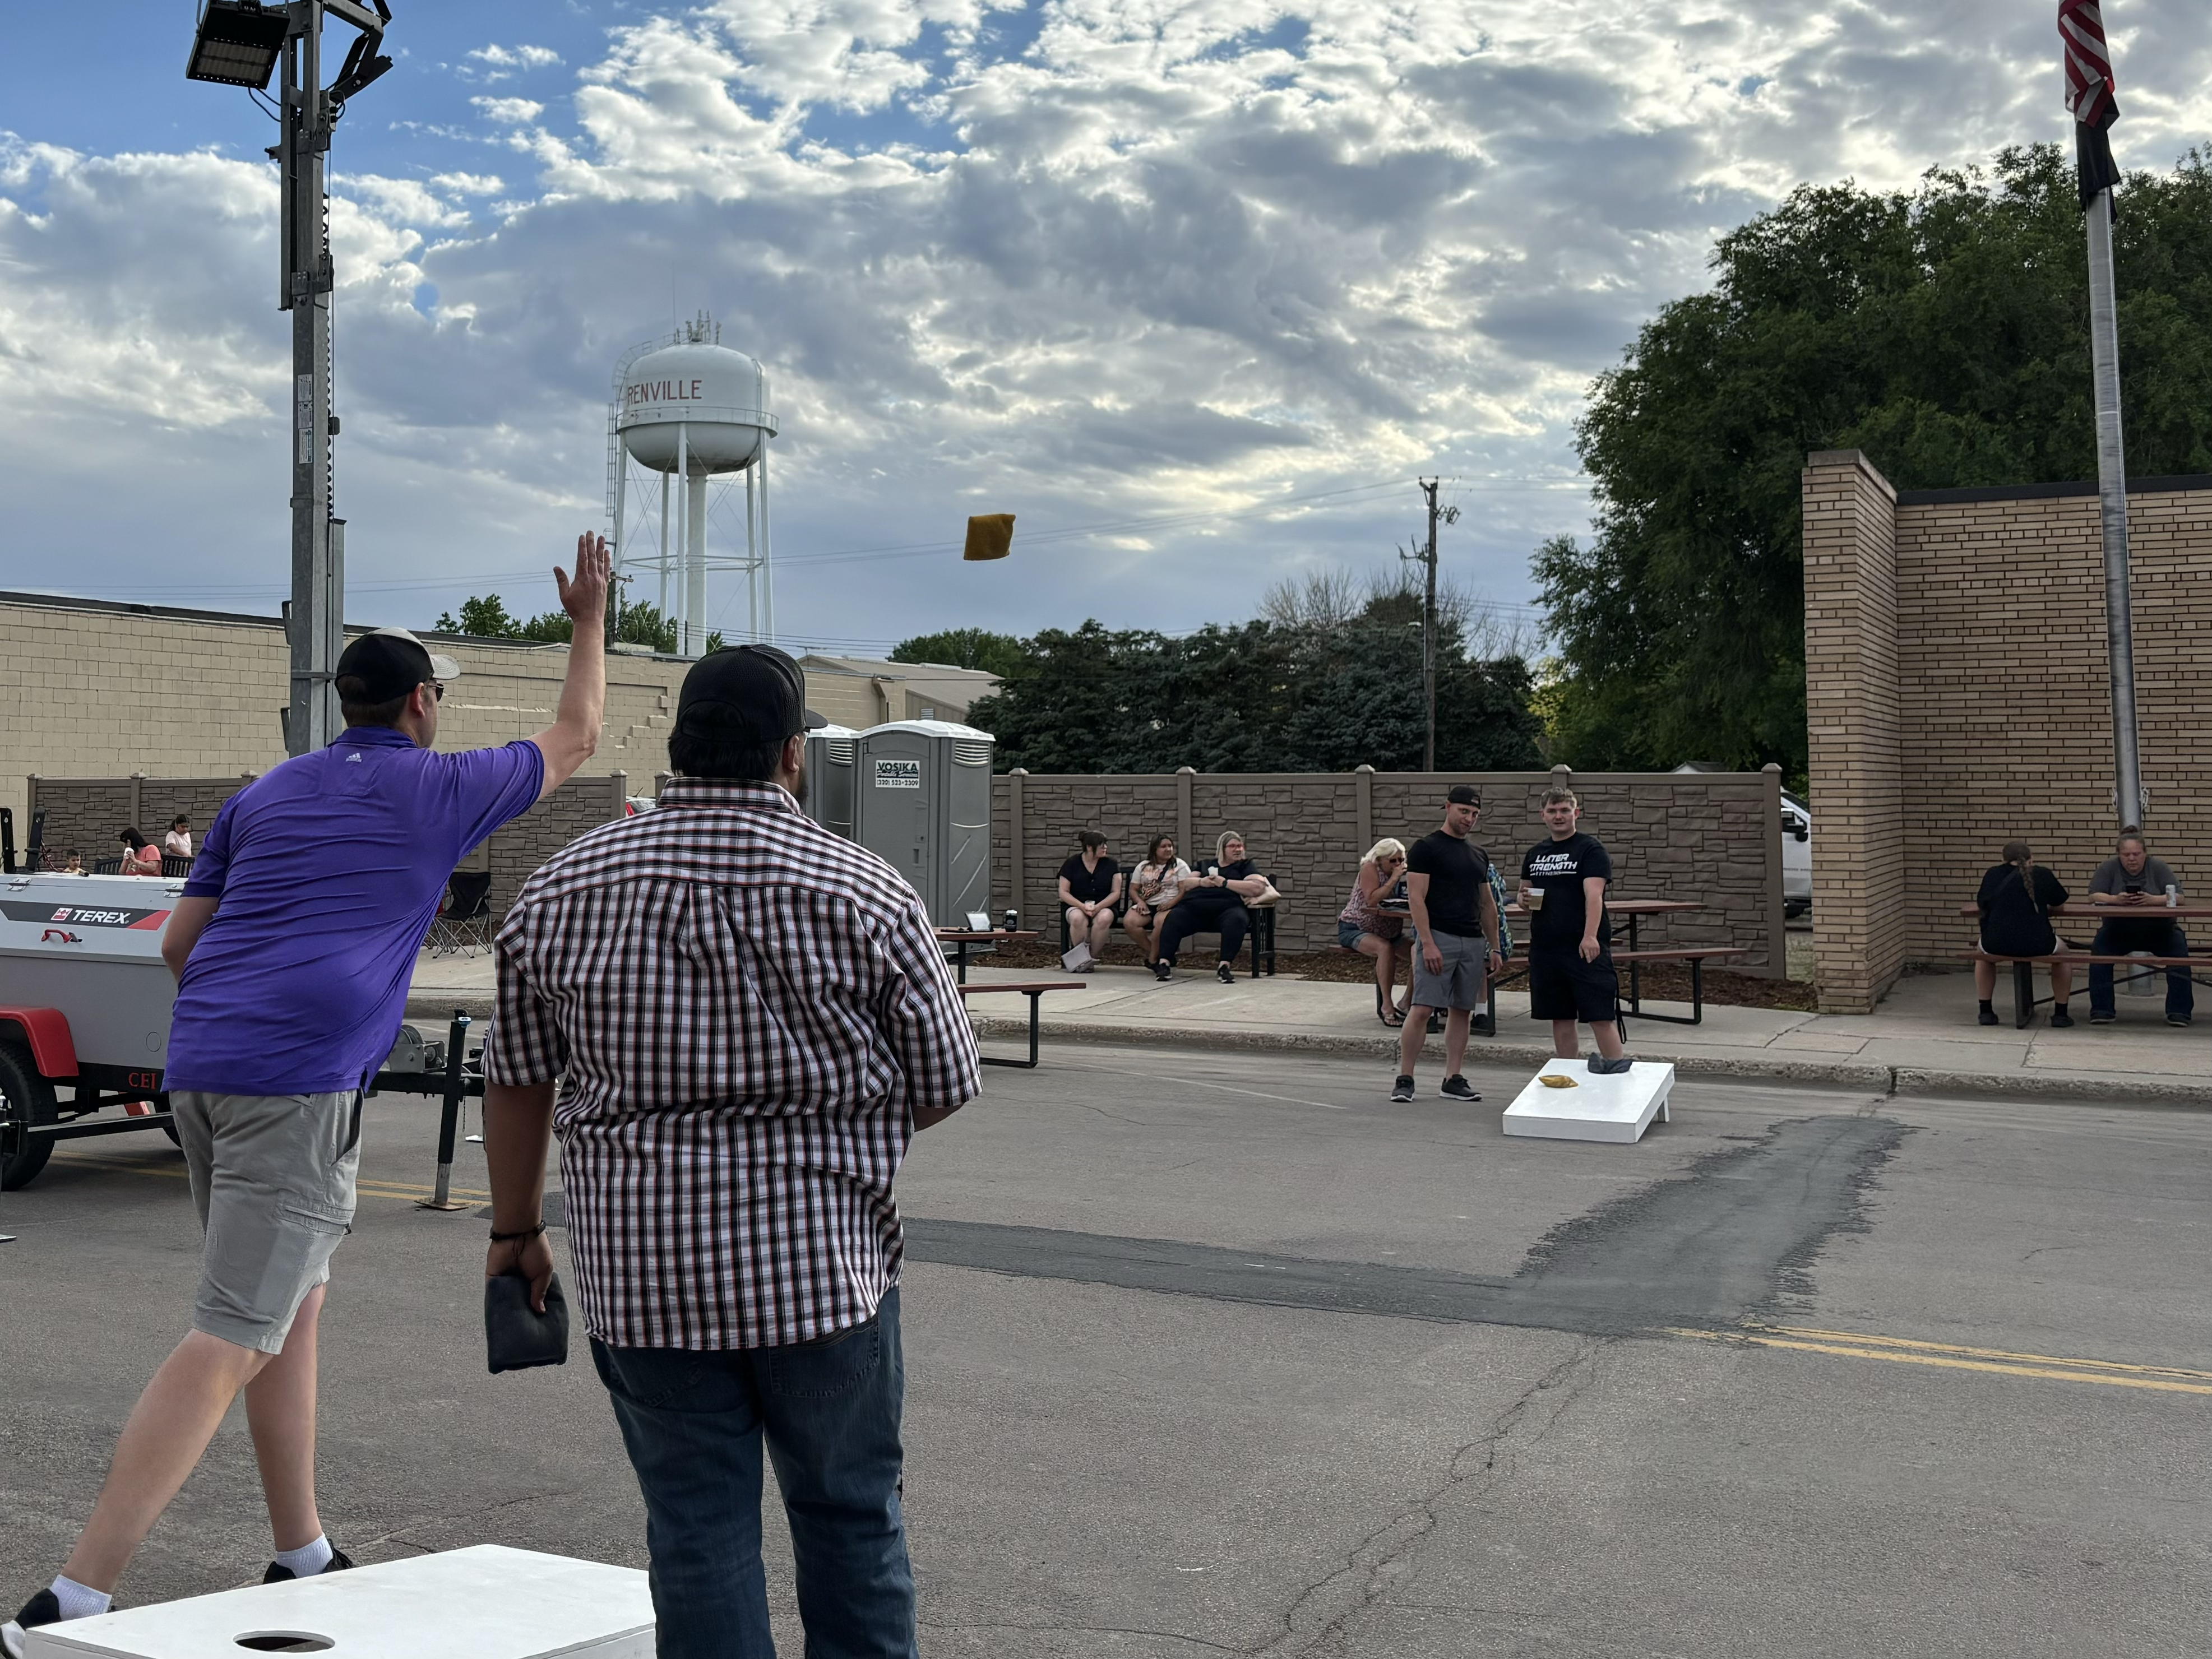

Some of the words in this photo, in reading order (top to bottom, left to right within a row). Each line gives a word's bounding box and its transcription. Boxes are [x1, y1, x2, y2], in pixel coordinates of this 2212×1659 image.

[627, 380, 702, 405] RENVILLE
[877, 762, 918, 771] VOSIKA
[1529, 861, 1578, 872] STRENGTH
[72, 909, 131, 924] TEREX
[128, 1073, 157, 1090] CEI
